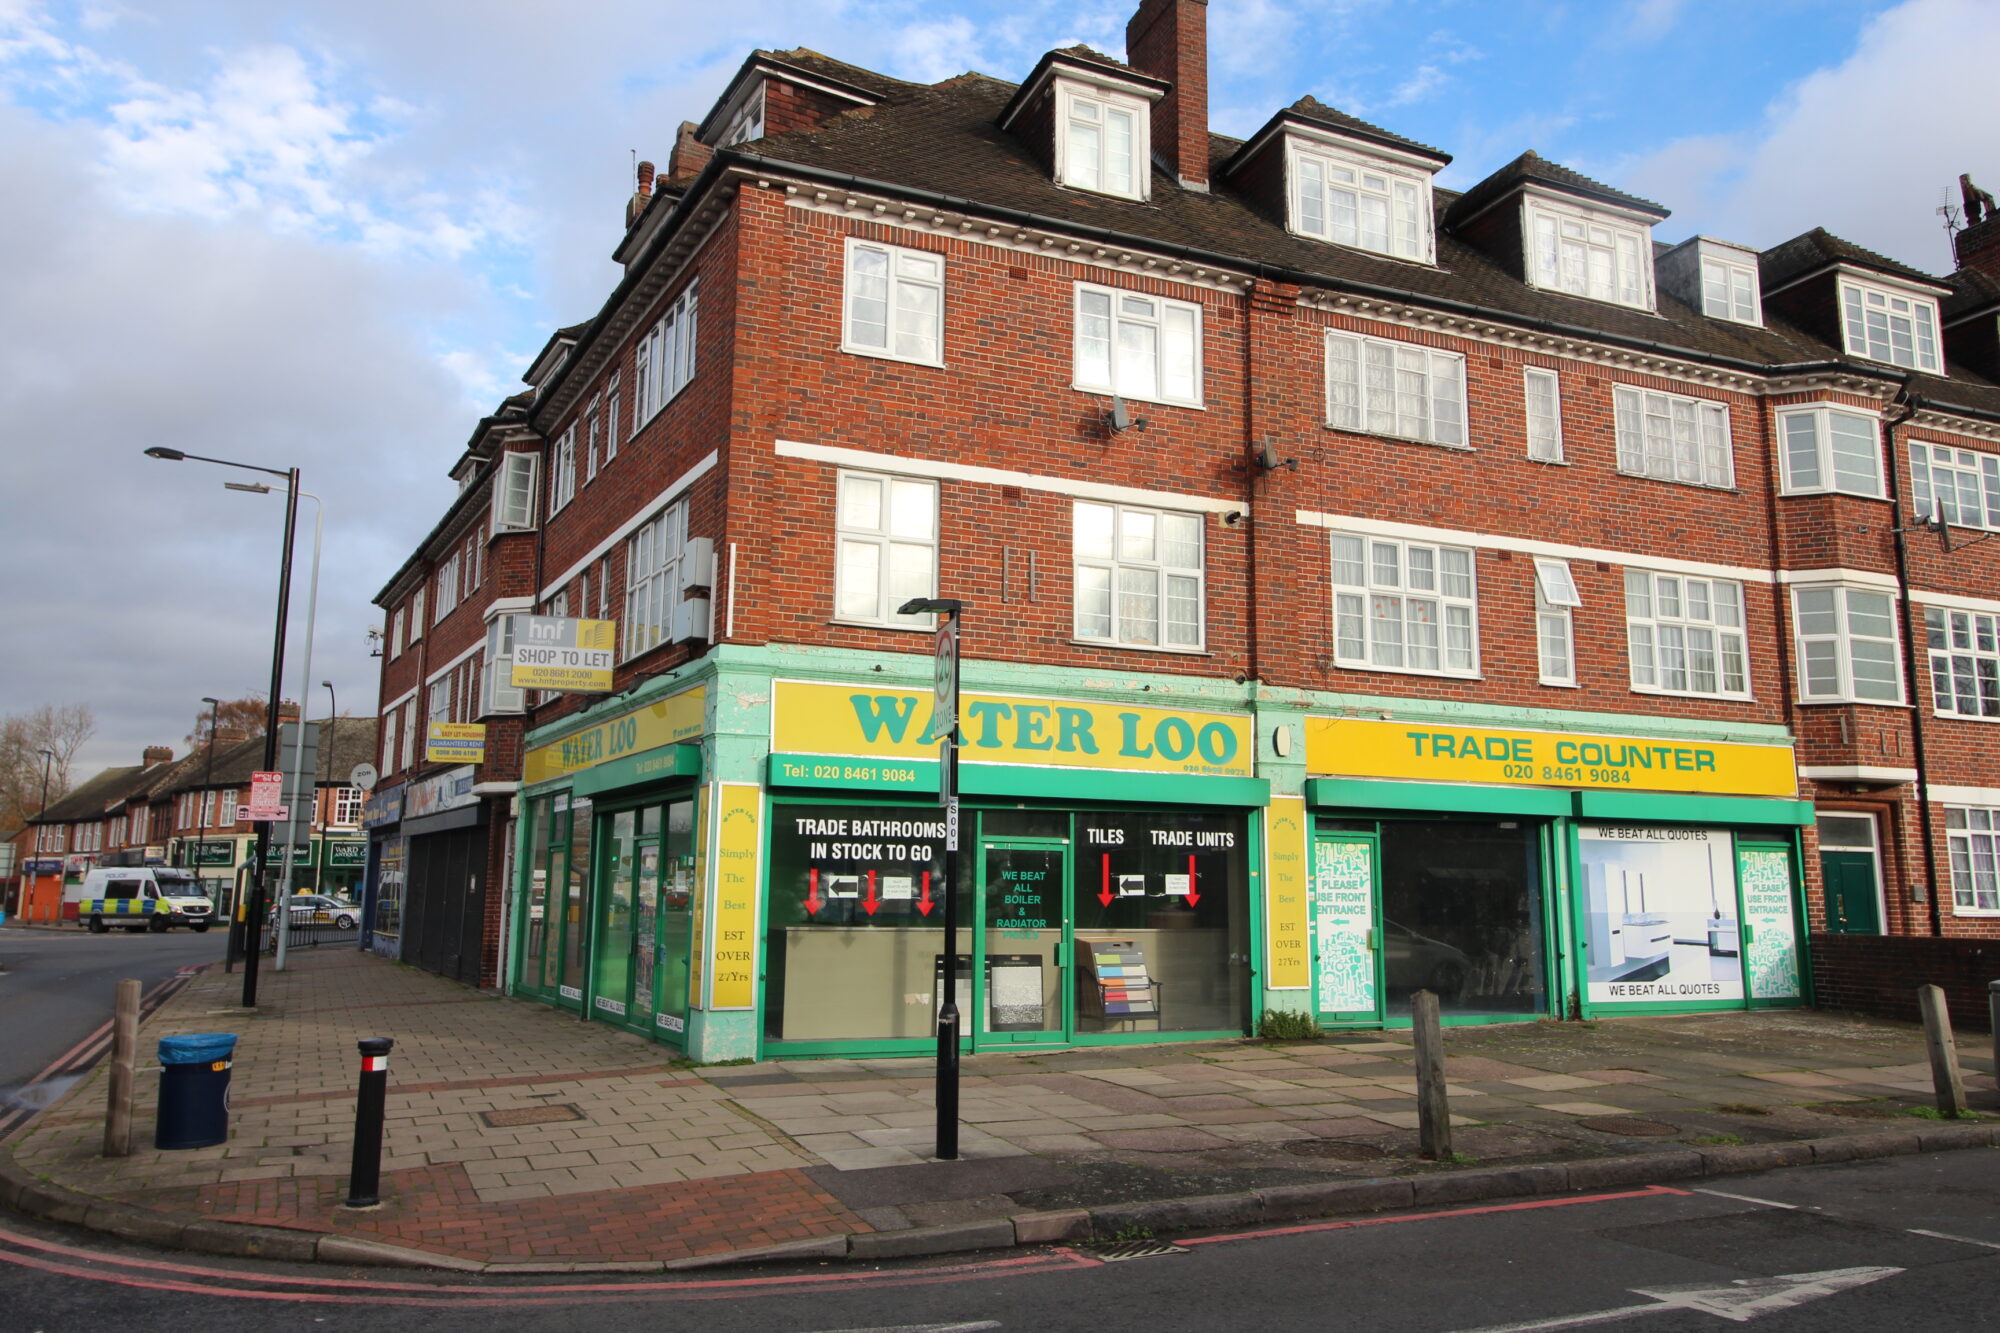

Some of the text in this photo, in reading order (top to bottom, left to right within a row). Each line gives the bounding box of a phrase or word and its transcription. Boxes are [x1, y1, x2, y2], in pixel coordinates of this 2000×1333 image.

[529, 618, 565, 639] hnf
[518, 648, 609, 667] SHOP TO LET
[938, 651, 950, 683] 20
[533, 668, 592, 679] 020 8681 2000
[518, 678, 606, 688] www.hnfproperty.com
[936, 705, 952, 730] ZONE
[562, 716, 637, 768] WATER LOO
[1118, 712, 1238, 765] LOO
[1406, 732, 1716, 772] TRADE COUNTER
[783, 764, 915, 782] Tel: 020 8461 9084
[1504, 764, 1631, 784] 020 8461 9084
[796, 819, 946, 839] TRADE BATHROOMS
[1599, 827, 1708, 841] WE BEAT ALL QUOTES
[1087, 828, 1234, 847] TILES TRADE UNITS
[719, 848, 755, 860] Simply
[810, 842, 932, 861] IN STOCK TO GO
[1273, 852, 1299, 862] Simply
[725, 873, 744, 883] The
[1002, 872, 1046, 880] WE BEAT
[1279, 874, 1293, 882] The
[1014, 884, 1032, 892] ALL
[1322, 880, 1358, 890] PLEASE
[1752, 883, 1781, 893] PLEASE
[1005, 895, 1041, 904] BOILER
[1279, 895, 1295, 903] Best
[1315, 892, 1366, 902] USE FRONT
[1747, 895, 1788, 903] USE FRONT
[724, 900, 746, 910] Best
[1316, 905, 1366, 915] ENTRANCE
[1749, 906, 1788, 914] ENTRANCE
[1019, 907, 1025, 916] &
[996, 919, 1046, 928] RADIATOR
[1280, 923, 1296, 931] EST
[724, 931, 745, 940] EST
[1003, 931, 1040, 940] PRICES
[1276, 940, 1301, 949] OVER
[716, 951, 750, 960] OVER
[718, 971, 749, 982] 27Yrs
[1609, 984, 1720, 996] WE BEAT ALL QUOTES
